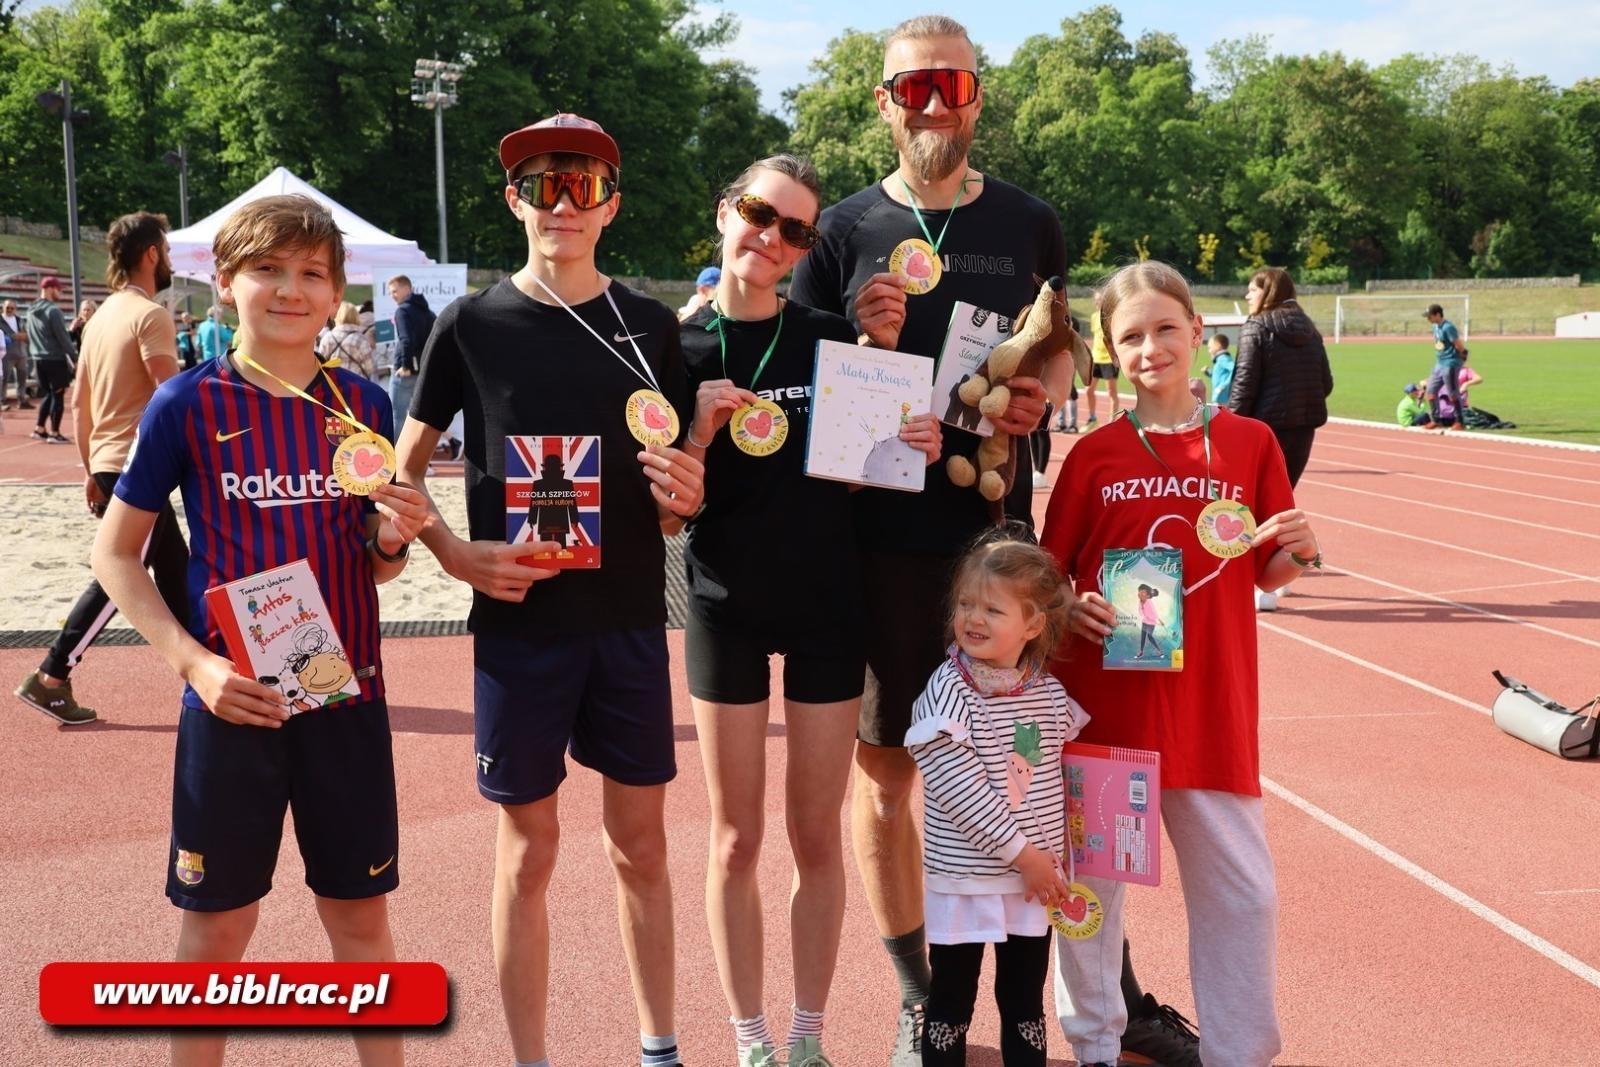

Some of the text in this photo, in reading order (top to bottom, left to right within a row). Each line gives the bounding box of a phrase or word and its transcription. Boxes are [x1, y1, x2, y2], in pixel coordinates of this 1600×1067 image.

[940, 254, 1015, 276] NNING
[220, 468, 352, 500] Rakute
[238, 585, 266, 597] Tomasz
[258, 622, 293, 654] jeszcze
[50, 699, 66, 708] FILA
